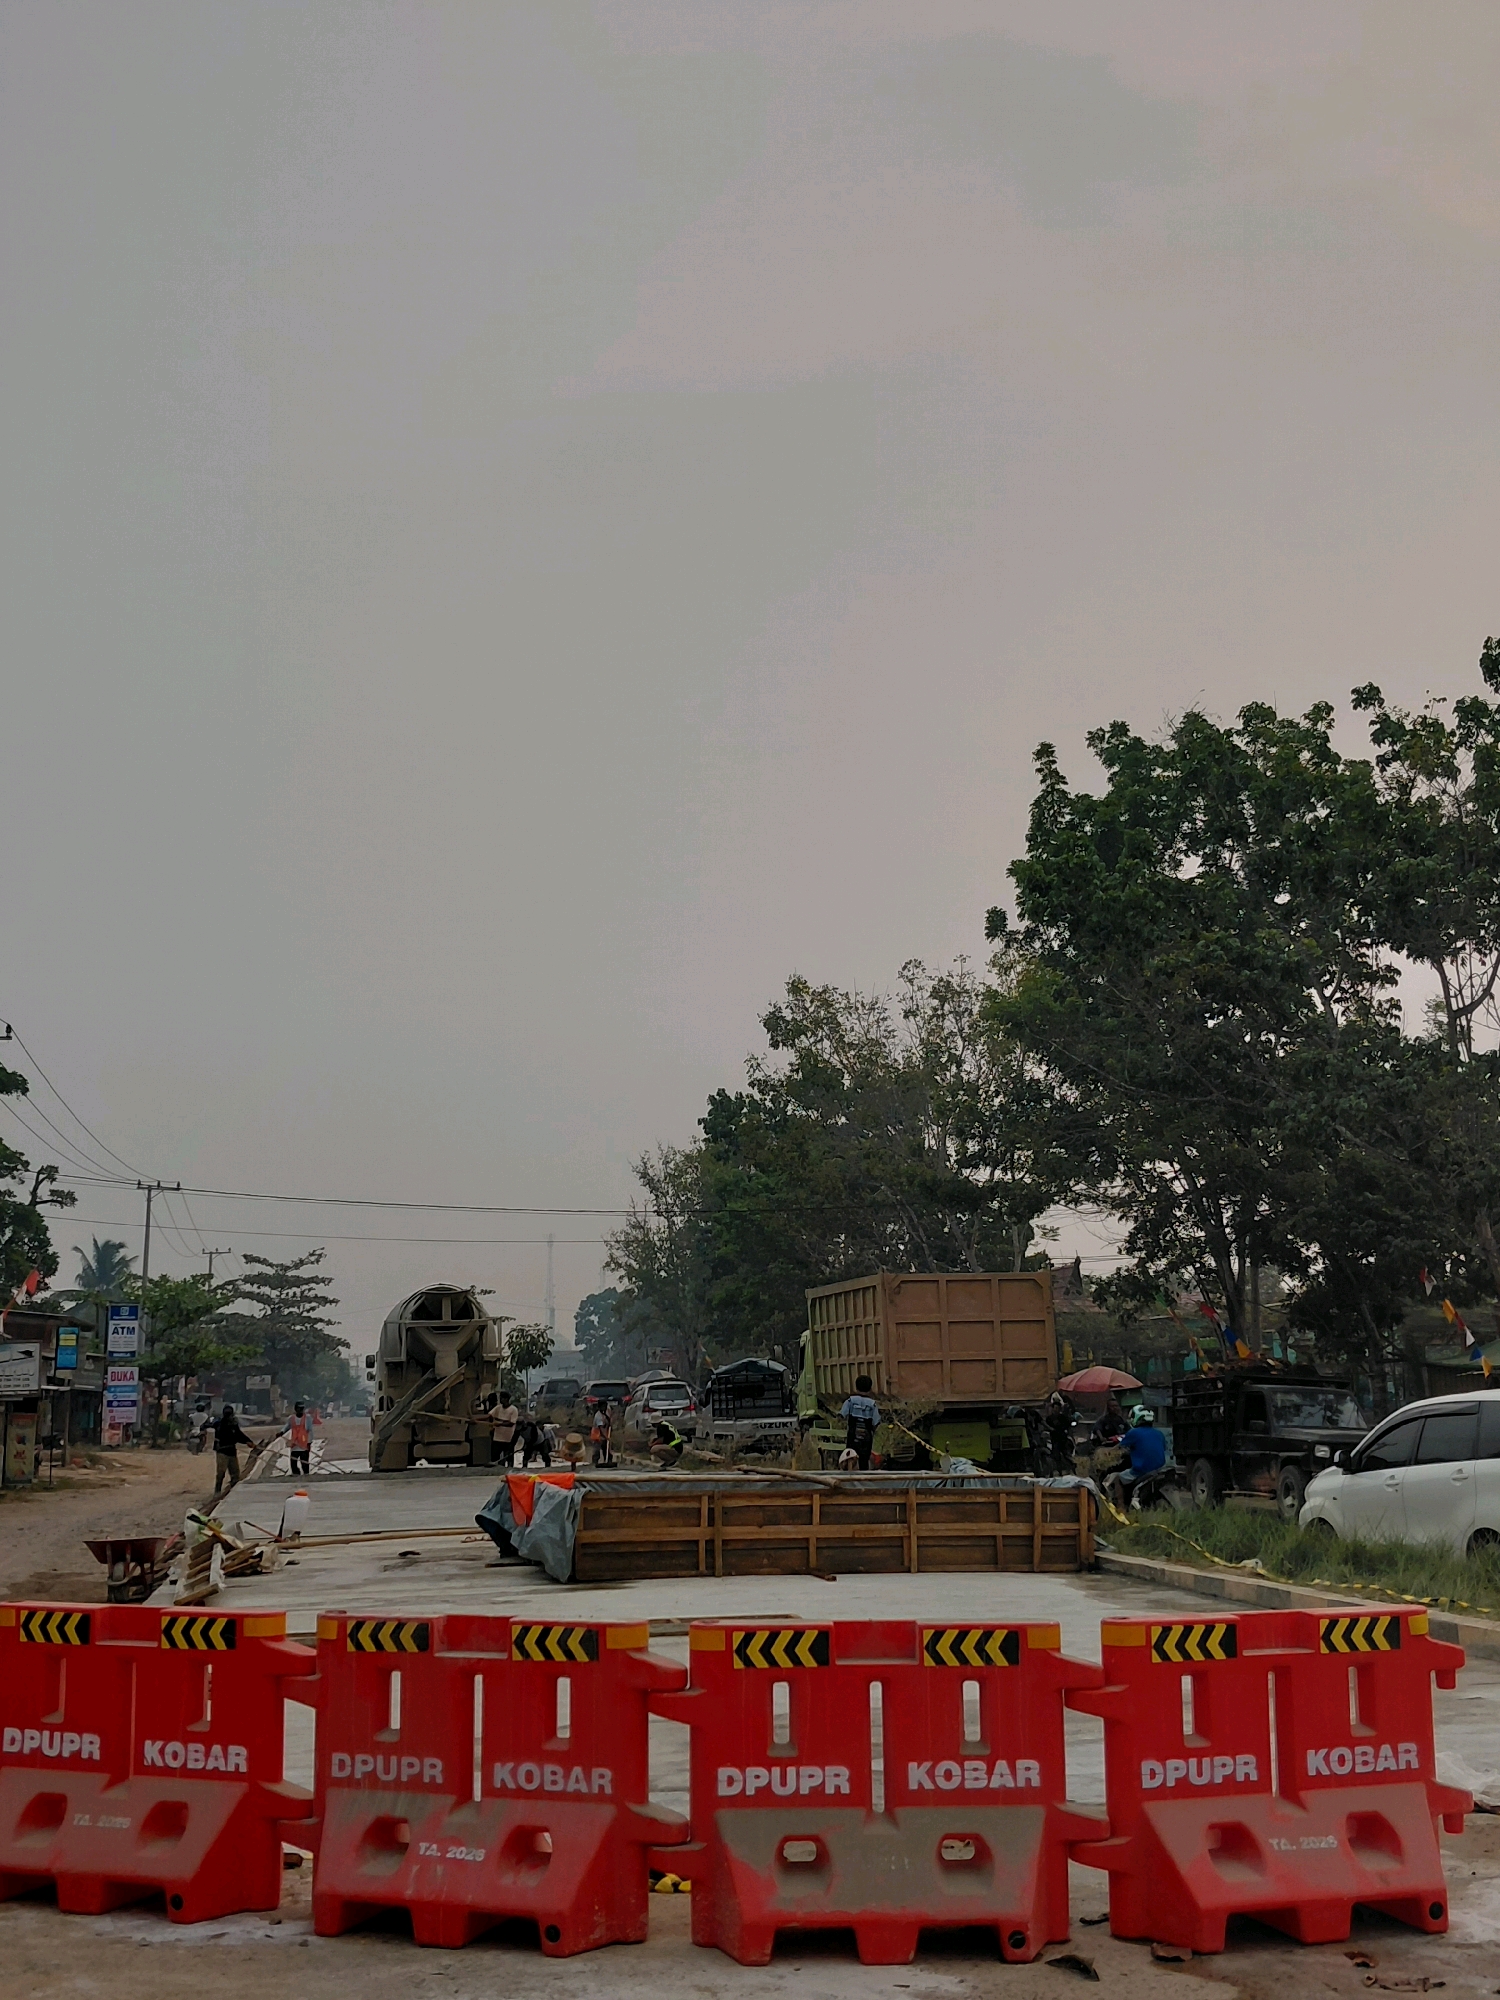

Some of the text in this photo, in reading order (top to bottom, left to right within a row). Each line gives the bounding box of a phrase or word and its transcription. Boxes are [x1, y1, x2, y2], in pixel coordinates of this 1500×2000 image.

[111, 1326, 136, 1336] ATM
[2, 1727, 248, 1773] DPUPR KOBAR
[1140, 1743, 1419, 1789] DPUPR KOBAR
[331, 1753, 613, 1795] DPUPR KOBAR
[717, 1759, 1041, 1797] DPUPR KOBAR
[419, 1842, 442, 1857] TA.
[1268, 1837, 1297, 1851] TA.
